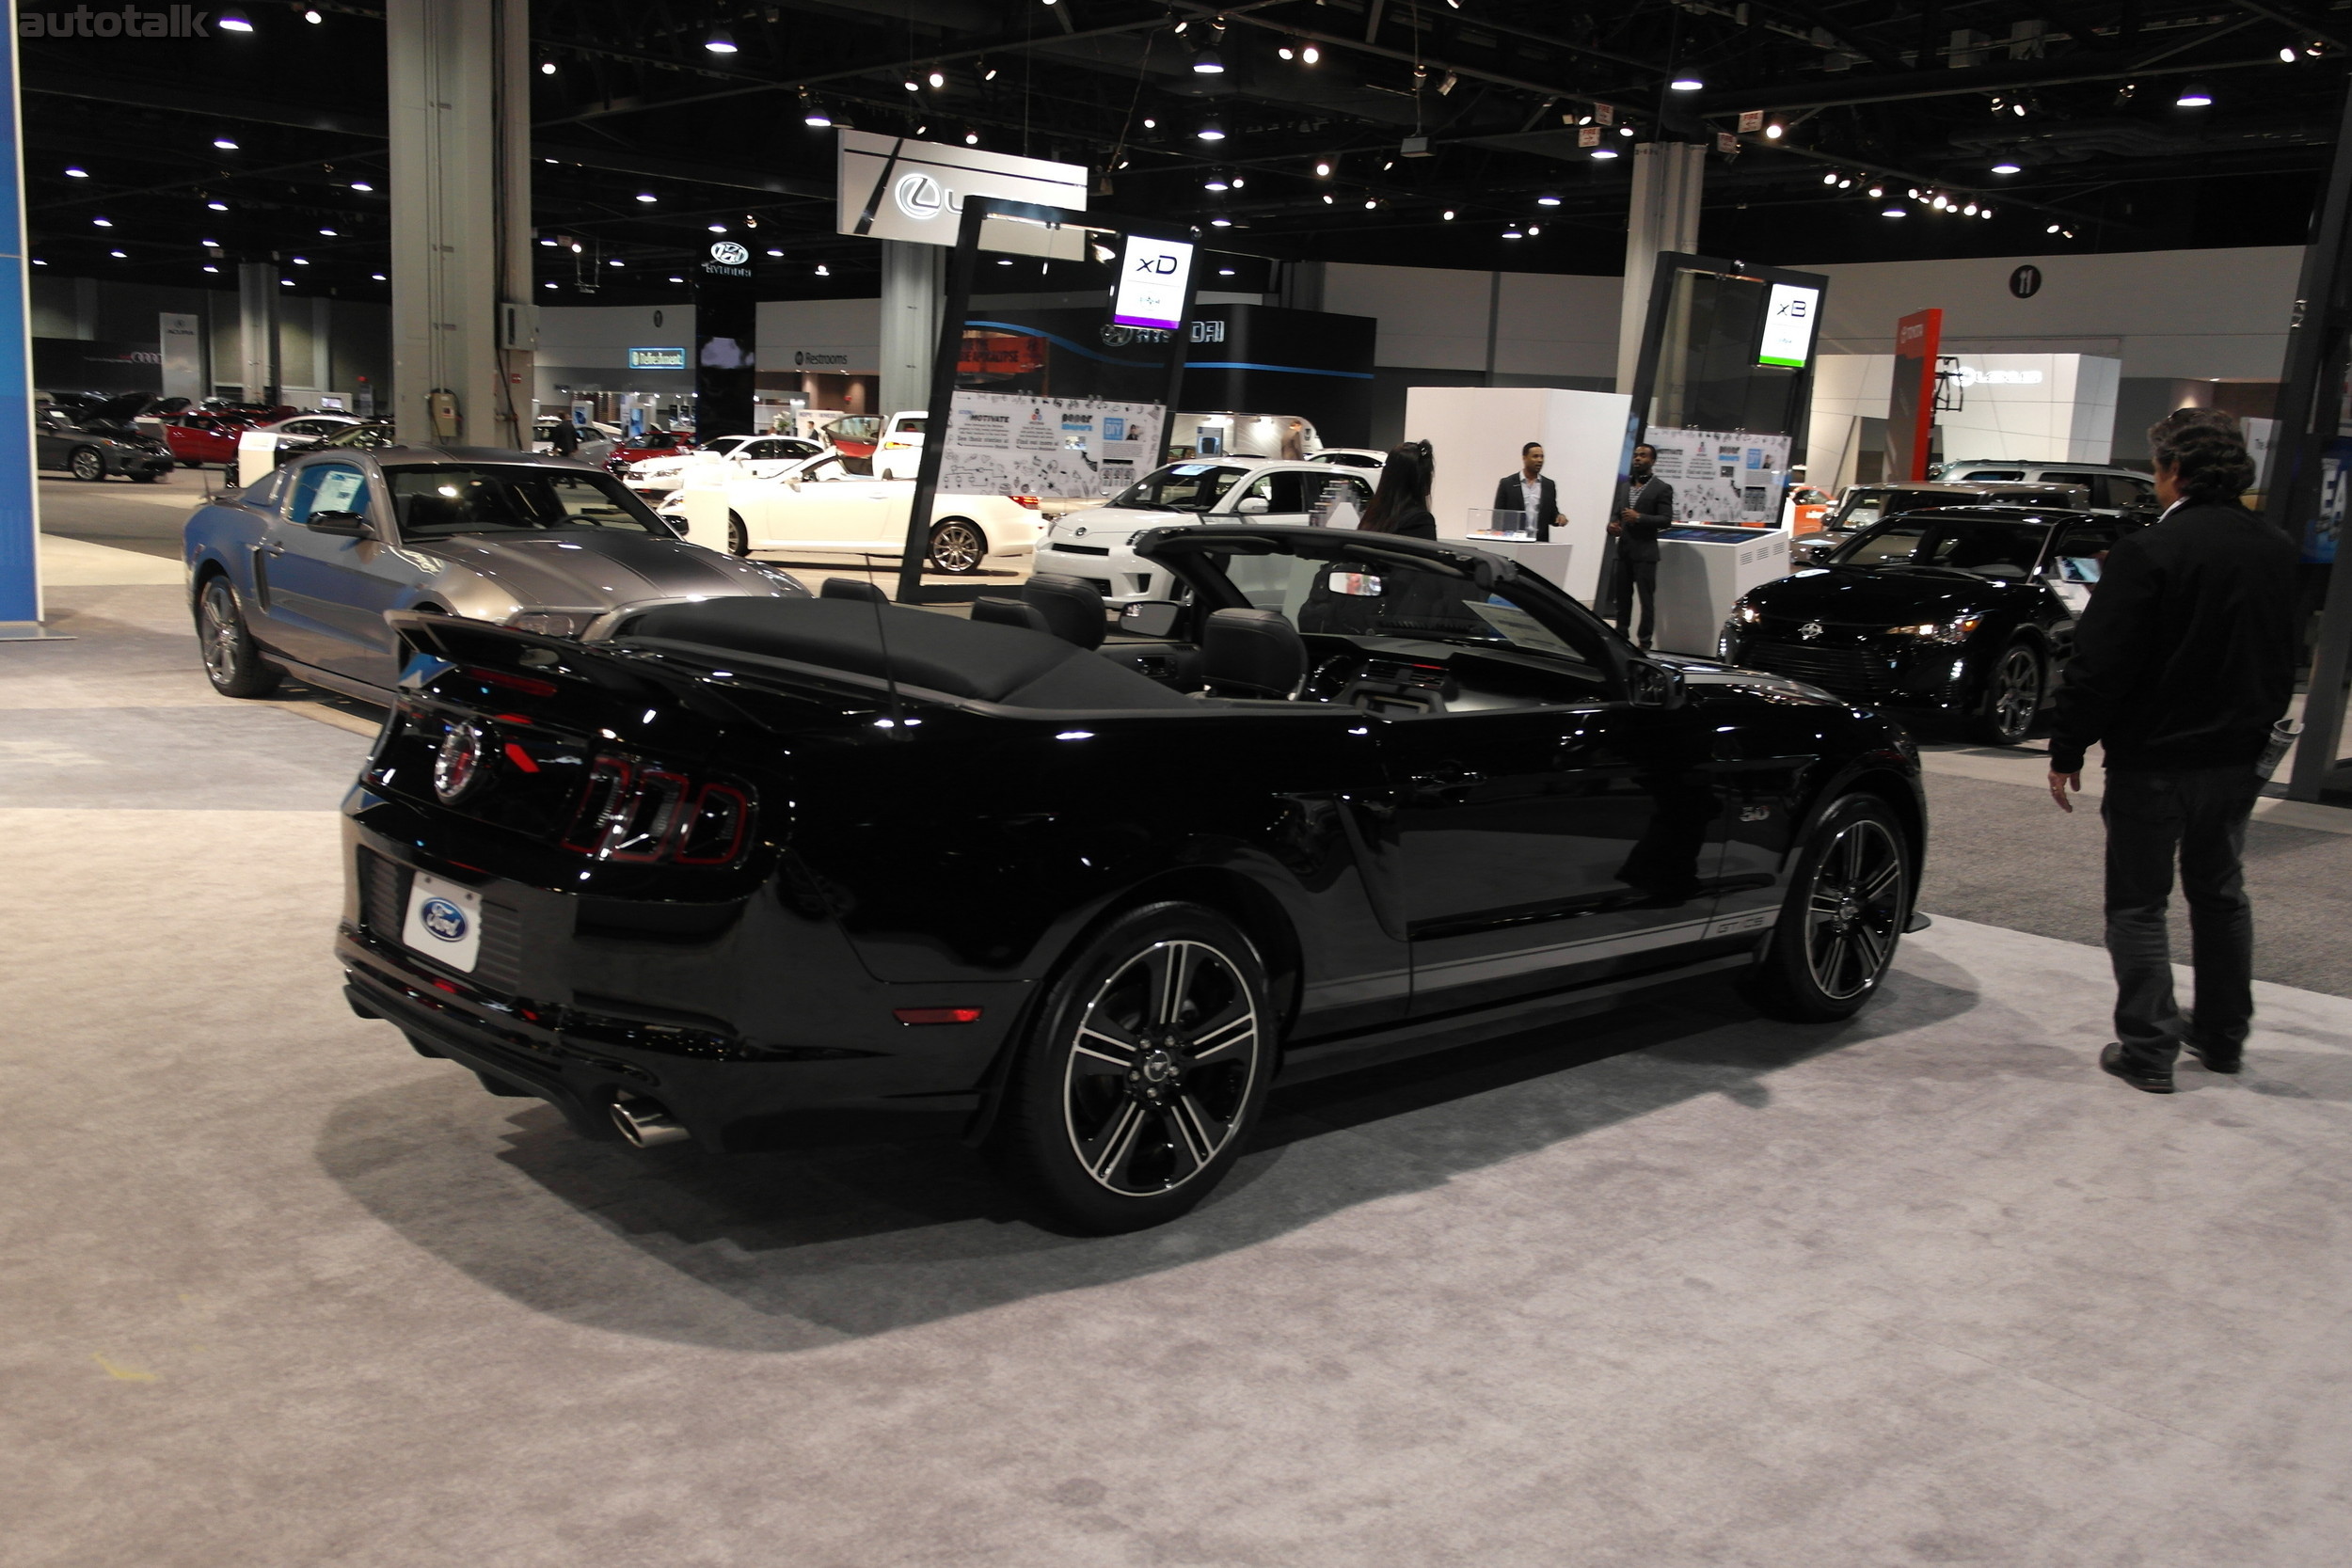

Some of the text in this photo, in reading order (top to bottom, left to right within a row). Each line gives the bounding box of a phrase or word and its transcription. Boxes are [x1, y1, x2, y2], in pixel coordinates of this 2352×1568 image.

[1136, 255, 1177, 275] xD
[1777, 300, 1806, 317] xB
[805, 352, 848, 365] Restrooms
[427, 903, 461, 936] Ford
